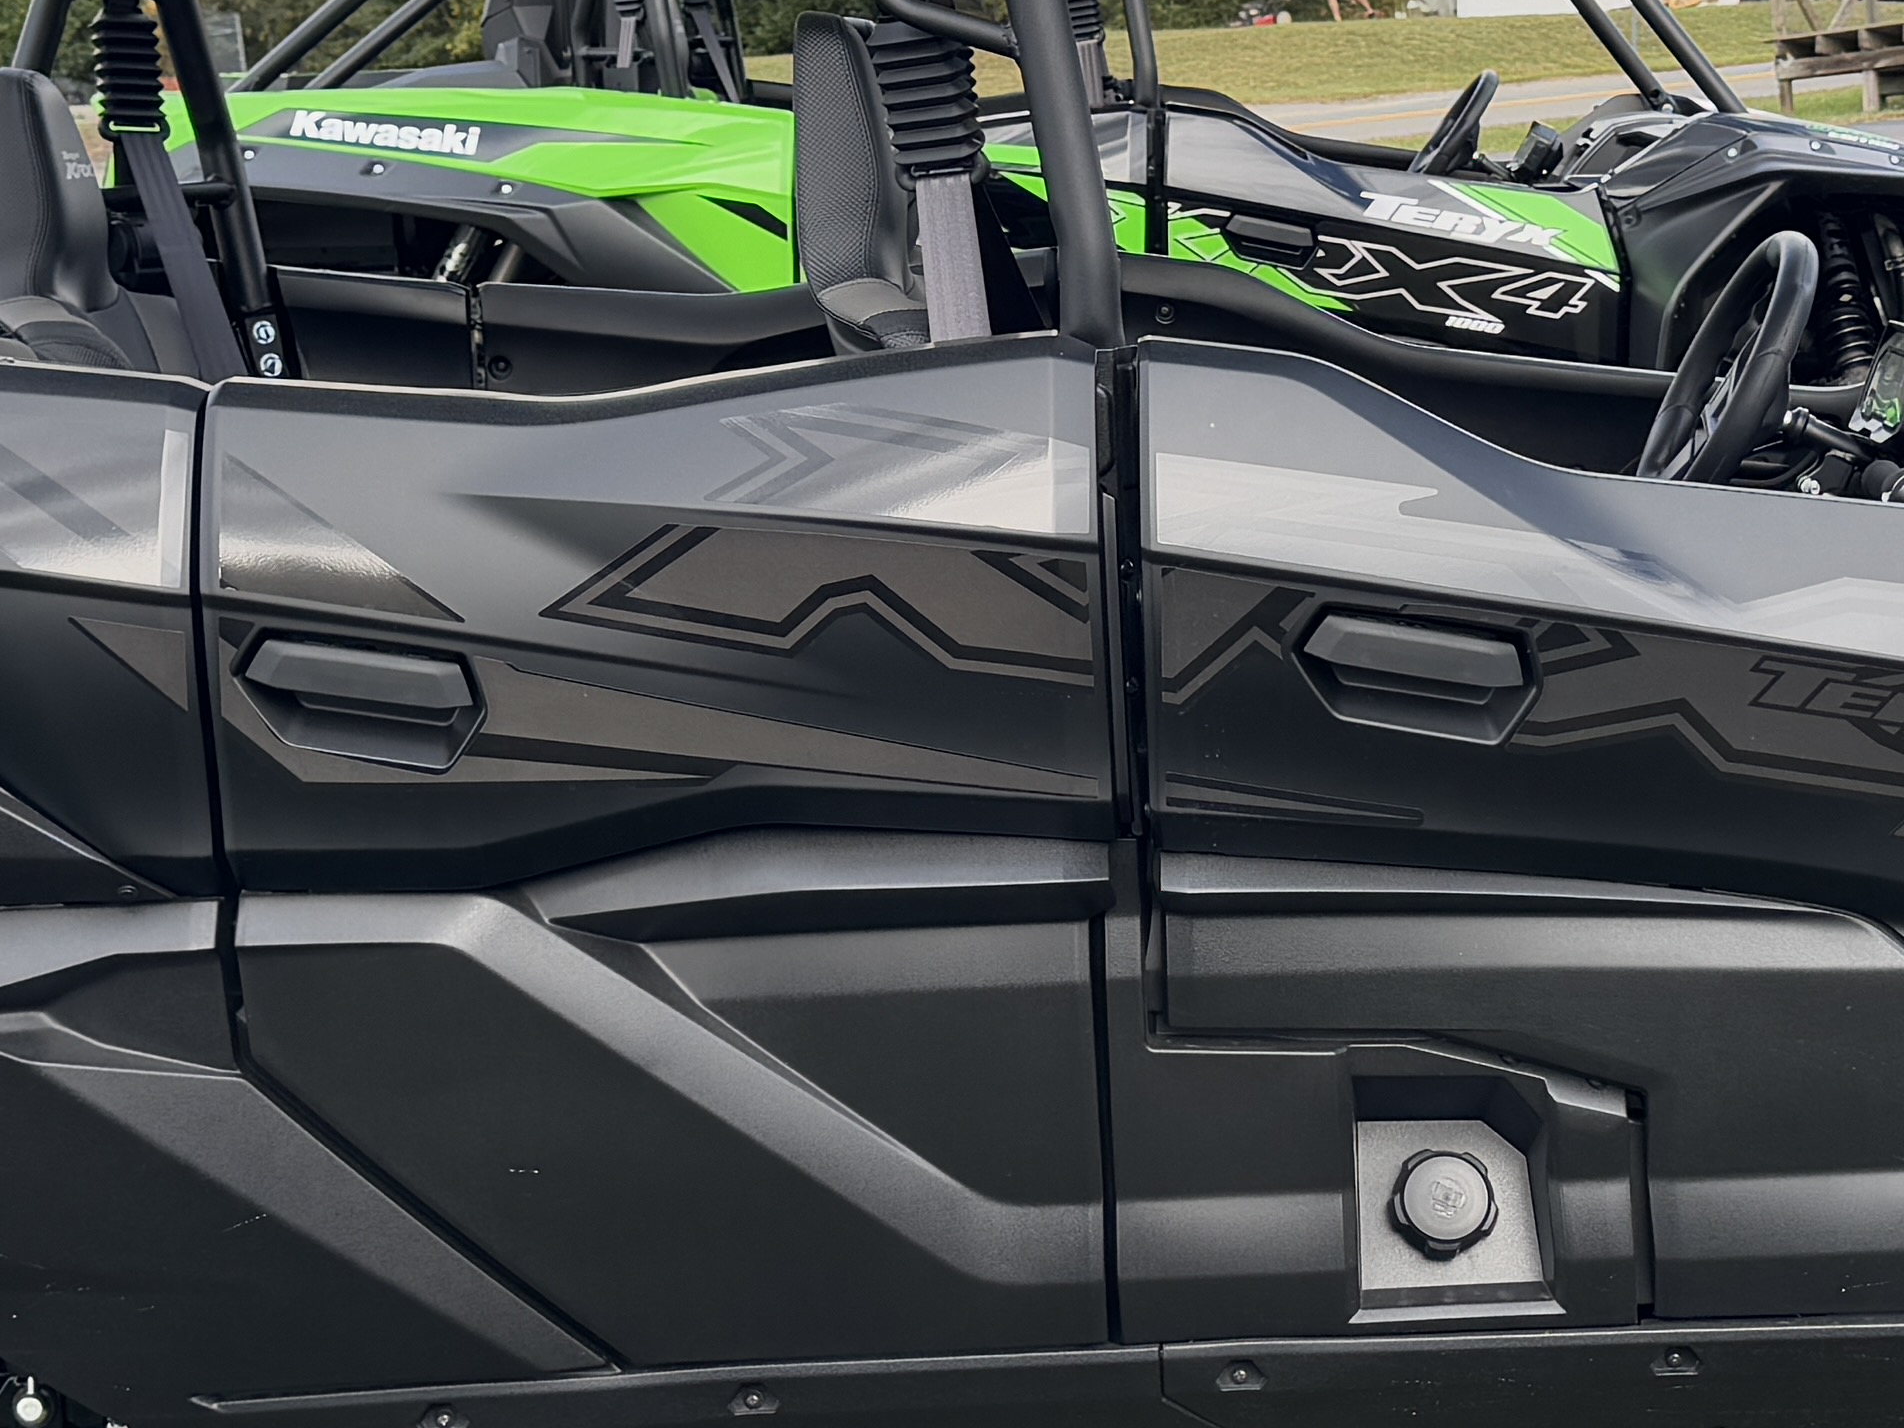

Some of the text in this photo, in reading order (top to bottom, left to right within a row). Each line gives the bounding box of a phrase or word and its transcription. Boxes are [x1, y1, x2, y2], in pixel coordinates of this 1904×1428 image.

[289, 110, 480, 155] Kawasaki
[1360, 191, 1568, 247] TERYX
[1445, 315, 1505, 335] 1000
